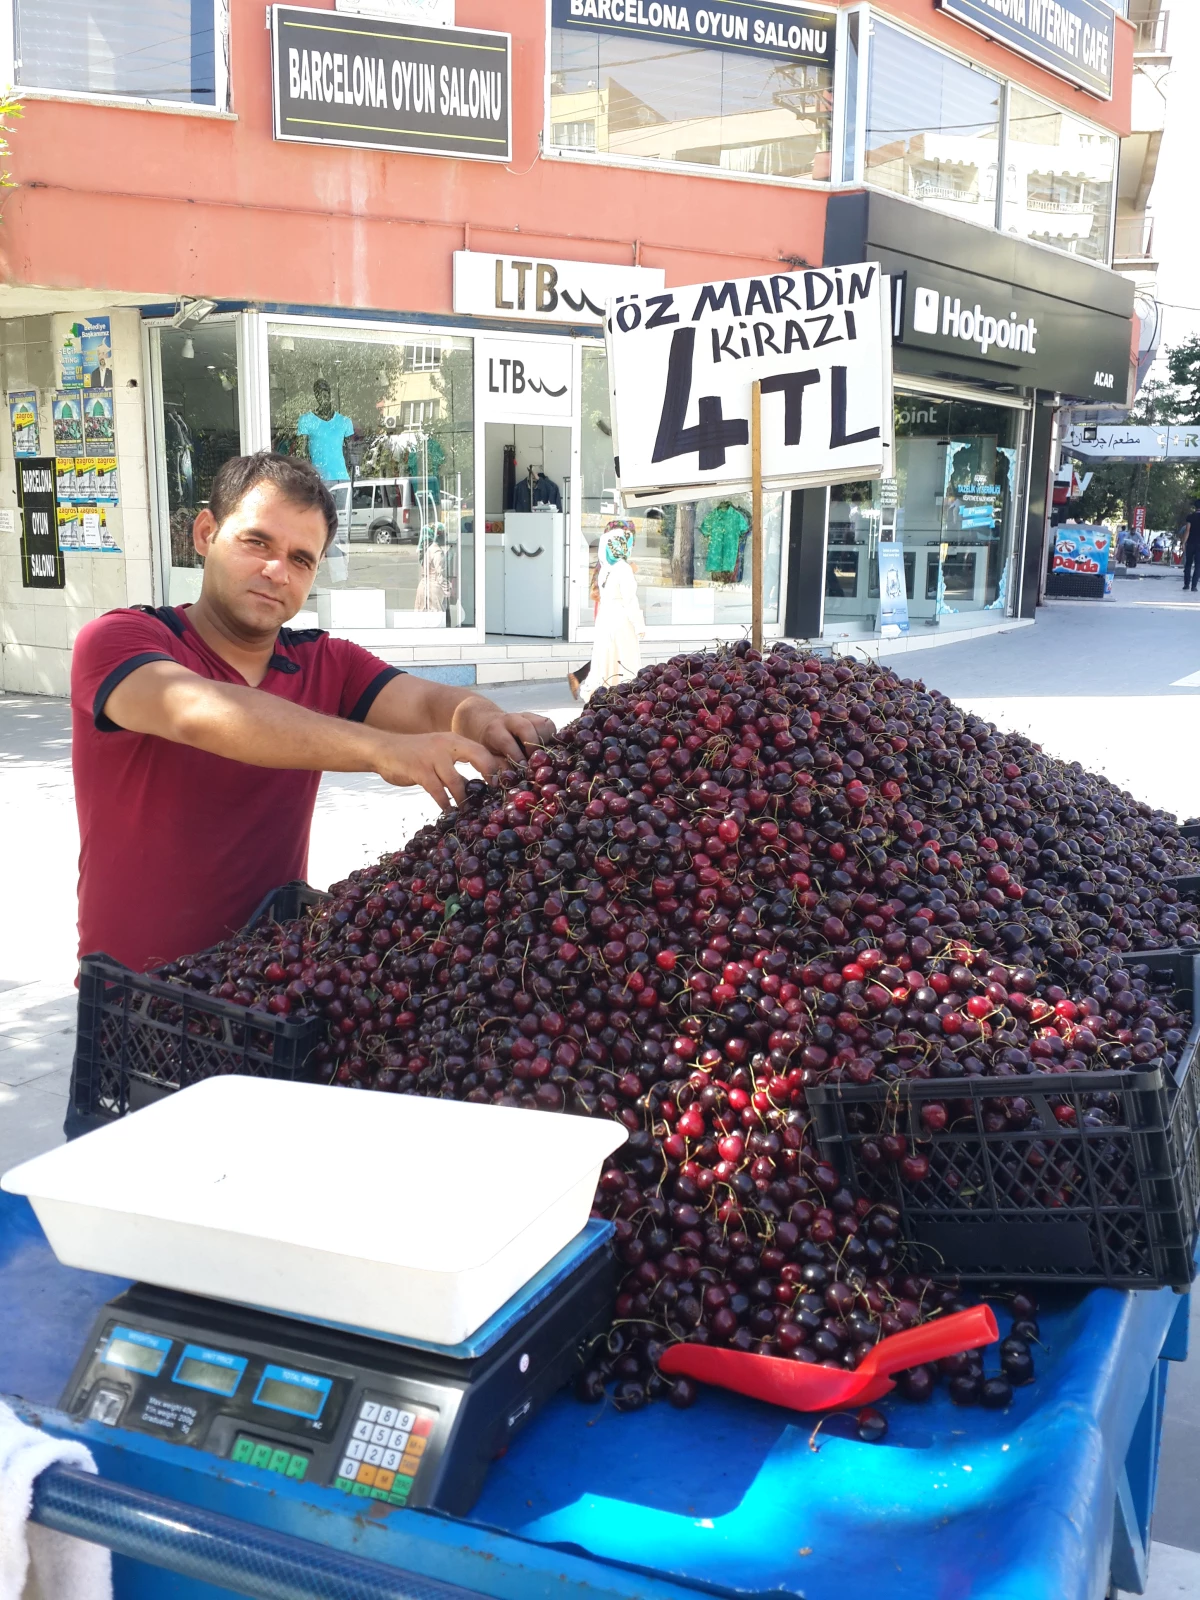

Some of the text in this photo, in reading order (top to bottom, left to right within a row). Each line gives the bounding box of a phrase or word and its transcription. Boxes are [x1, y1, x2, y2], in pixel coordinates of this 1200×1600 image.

[571, 0, 827, 54] BARCELONA OYUN SALONU
[1028, 0, 1082, 58] INTERNET
[1082, 22, 1109, 76] CAFÉ
[288, 47, 502, 121] BARCELONA OYUN SALONU
[494, 259, 559, 313] LTB
[615, 293, 680, 333] ÖZ
[942, 295, 1038, 355] Hotpoint
[488, 357, 526, 394] LTB
[1093, 370, 1114, 389] ACAR
[651, 327, 881, 471] 4 TL
[76, 458, 94, 466] zagros
[97, 458, 116, 466] zagros
[22, 469, 53, 493] BARCELONA
[59, 507, 77, 516] zagros
[31, 512, 49, 535] OYUN
[30, 553, 55, 577] SALONU
[282, 1369, 320, 1387] TOTAL PRICE
[367, 1405, 409, 1427] 7 8 9
[359, 1425, 367, 1436] 4
[376, 1429, 385, 1441] 5
[394, 1434, 403, 1446] 6
[354, 1444, 359, 1455] 1
[370, 1449, 378, 1461] 2
[387, 1453, 396, 1466] 3
[345, 1462, 353, 1475] 0
